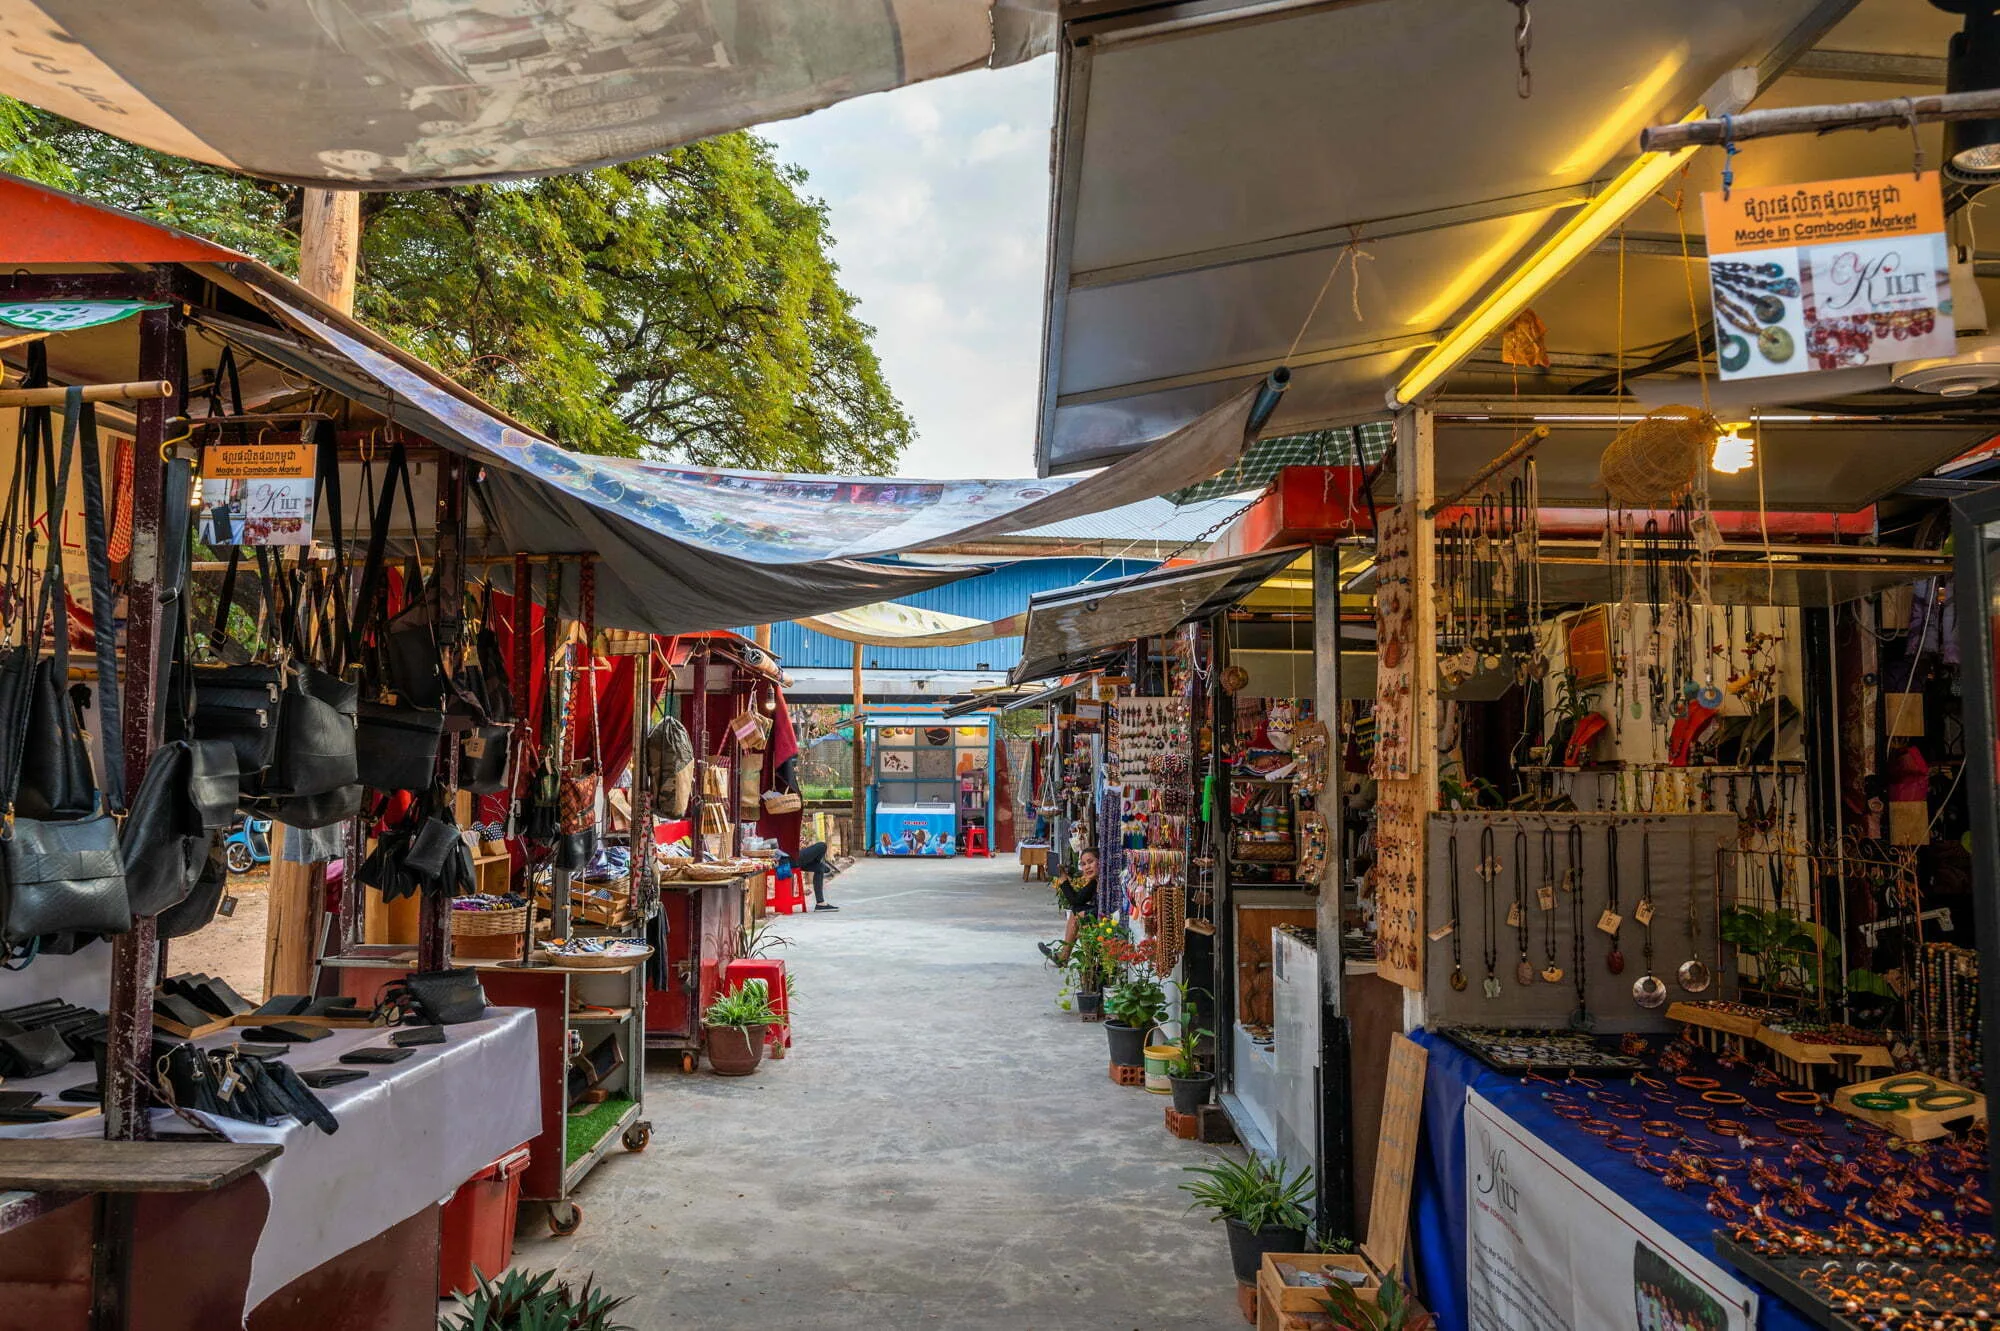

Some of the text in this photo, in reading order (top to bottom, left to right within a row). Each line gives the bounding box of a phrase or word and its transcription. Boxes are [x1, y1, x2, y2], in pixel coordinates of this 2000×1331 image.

[1734, 227, 1774, 241] Made
[1777, 226, 1790, 237] in
[1793, 219, 1866, 236] Cambodia
[1870, 213, 1917, 228] Market
[215, 466, 234, 474] Made
